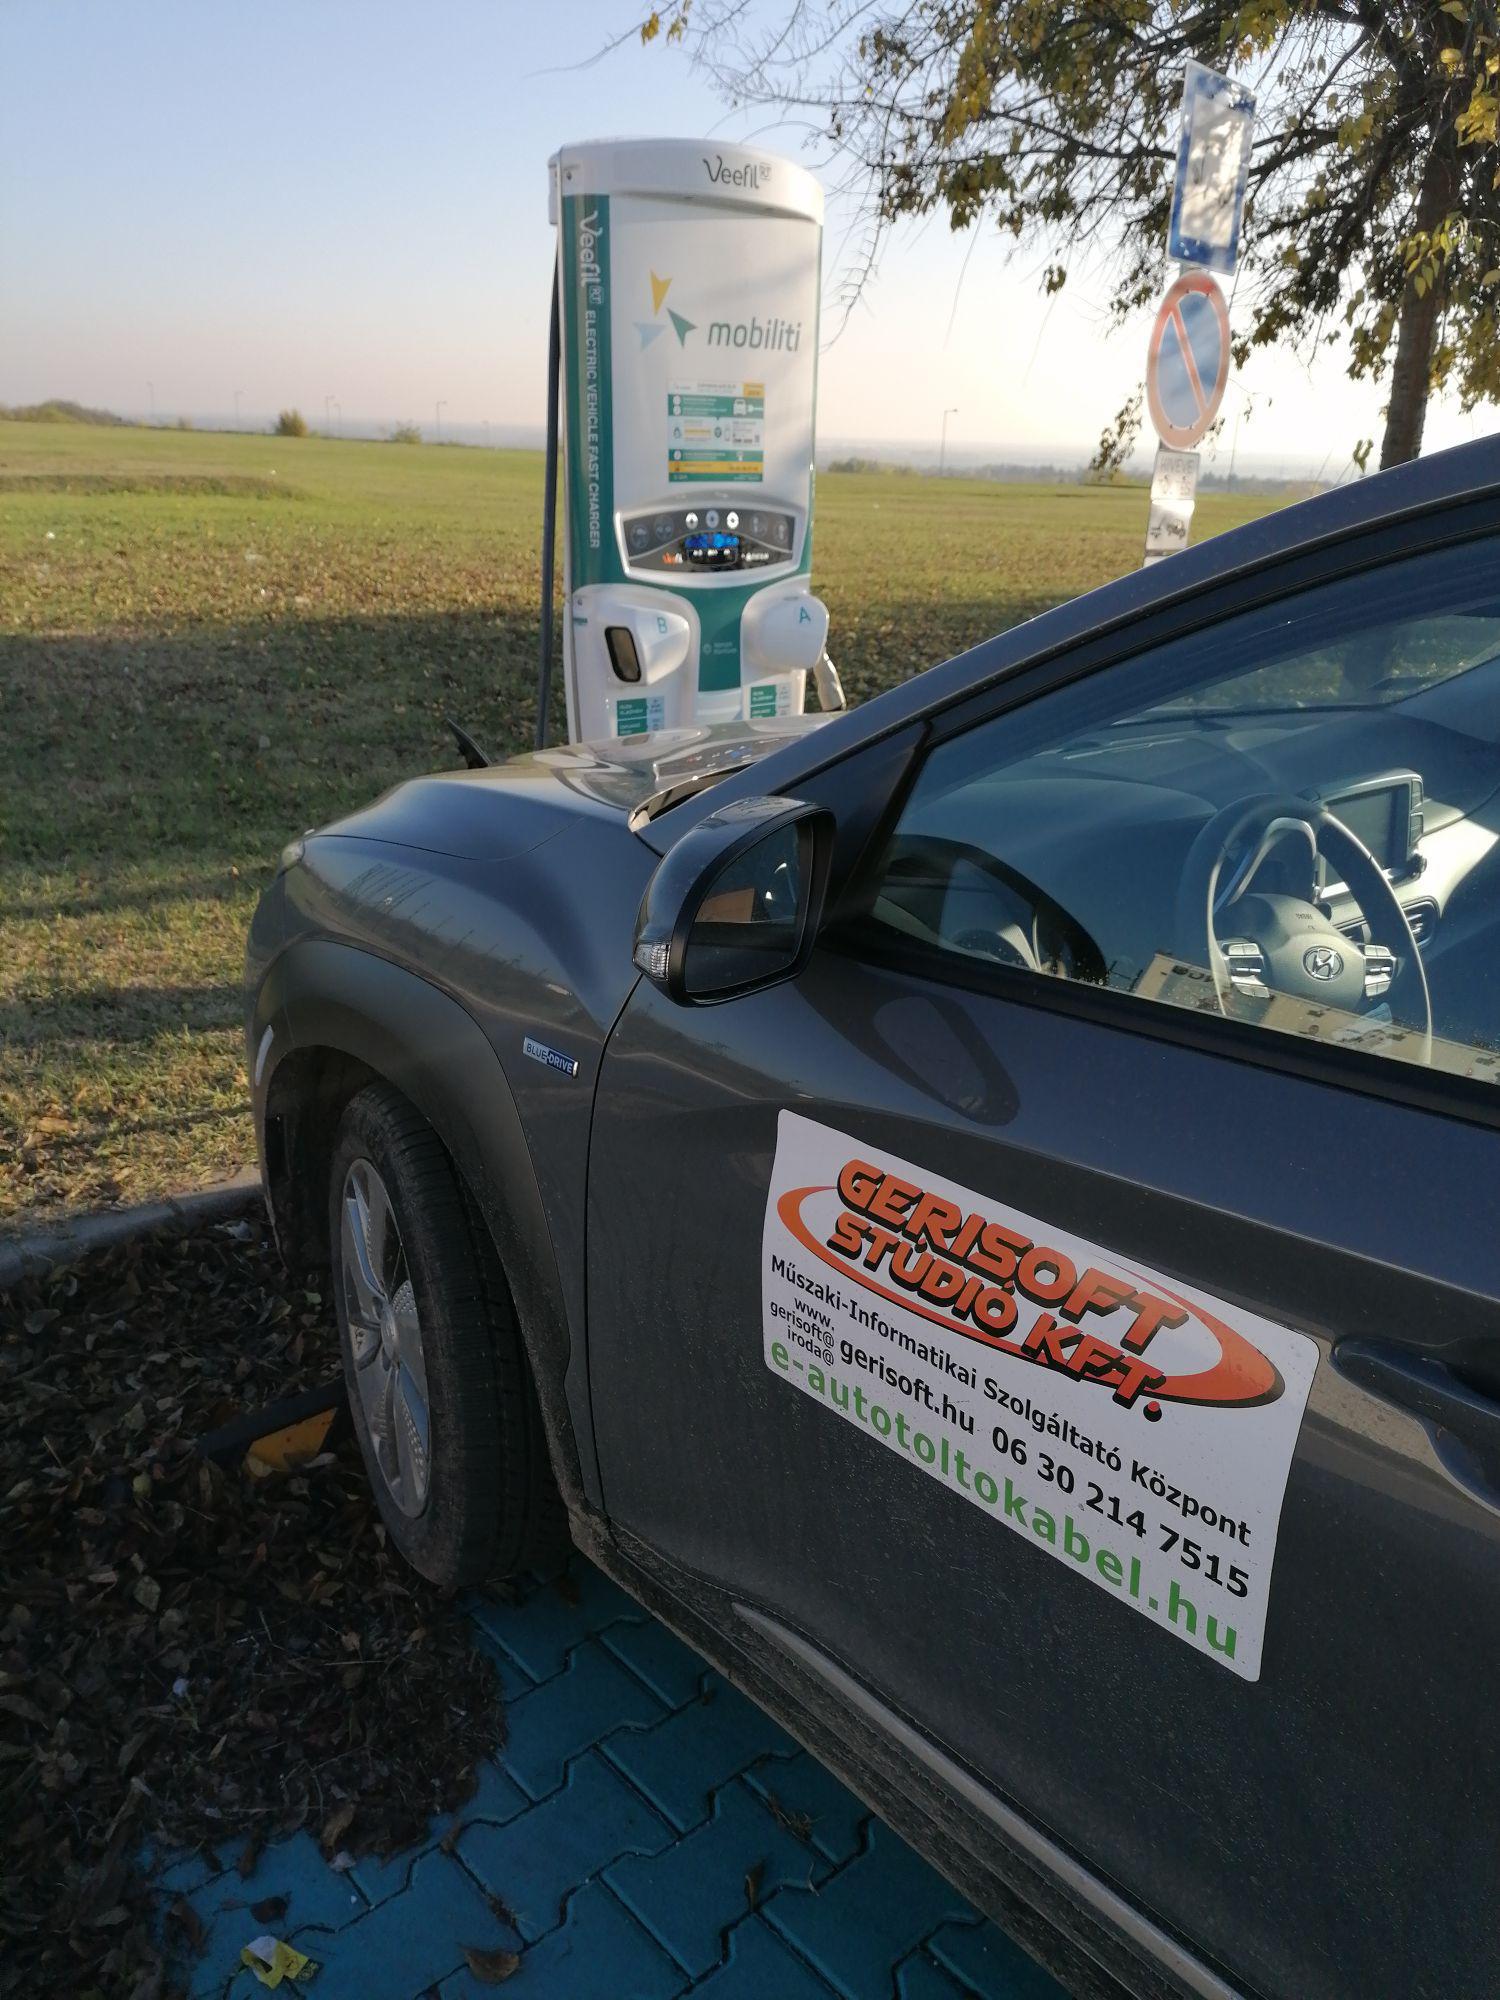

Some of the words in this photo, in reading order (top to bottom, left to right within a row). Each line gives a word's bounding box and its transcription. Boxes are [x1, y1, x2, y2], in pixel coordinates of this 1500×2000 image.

[702, 154, 760, 190] Veefil
[579, 209, 603, 288] Veefil
[584, 310, 597, 380] ELECTRIC
[707, 318, 802, 352] mobiliti
[586, 383, 599, 443] VEHICLE
[587, 446, 600, 482] FAST
[588, 484, 601, 549] CHARGER
[656, 617, 668, 634] B
[798, 606, 812, 624] A
[837, 1158, 1190, 1358] GERISOFT
[770, 1301, 835, 1348] gerisoft@
[794, 1297, 835, 1331] www.
[827, 1212, 1019, 1340] STÚDIÓ
[1020, 1313, 1166, 1423] KFT.
[787, 1326, 835, 1367] iroda@
[770, 1254, 978, 1390] Műszaki-Informatikai
[983, 1377, 1123, 1472] Szolgáltató
[1131, 1460, 1252, 1547] Központ
[840, 1339, 976, 1437] gerisoft.hu
[991, 1426, 1029, 1467] 06
[1037, 1453, 1076, 1494] 30
[1085, 1483, 1148, 1539] 214
[1159, 1524, 1250, 1599] 7515
[770, 1339, 1238, 1660] e-autotoltokabel.hu
